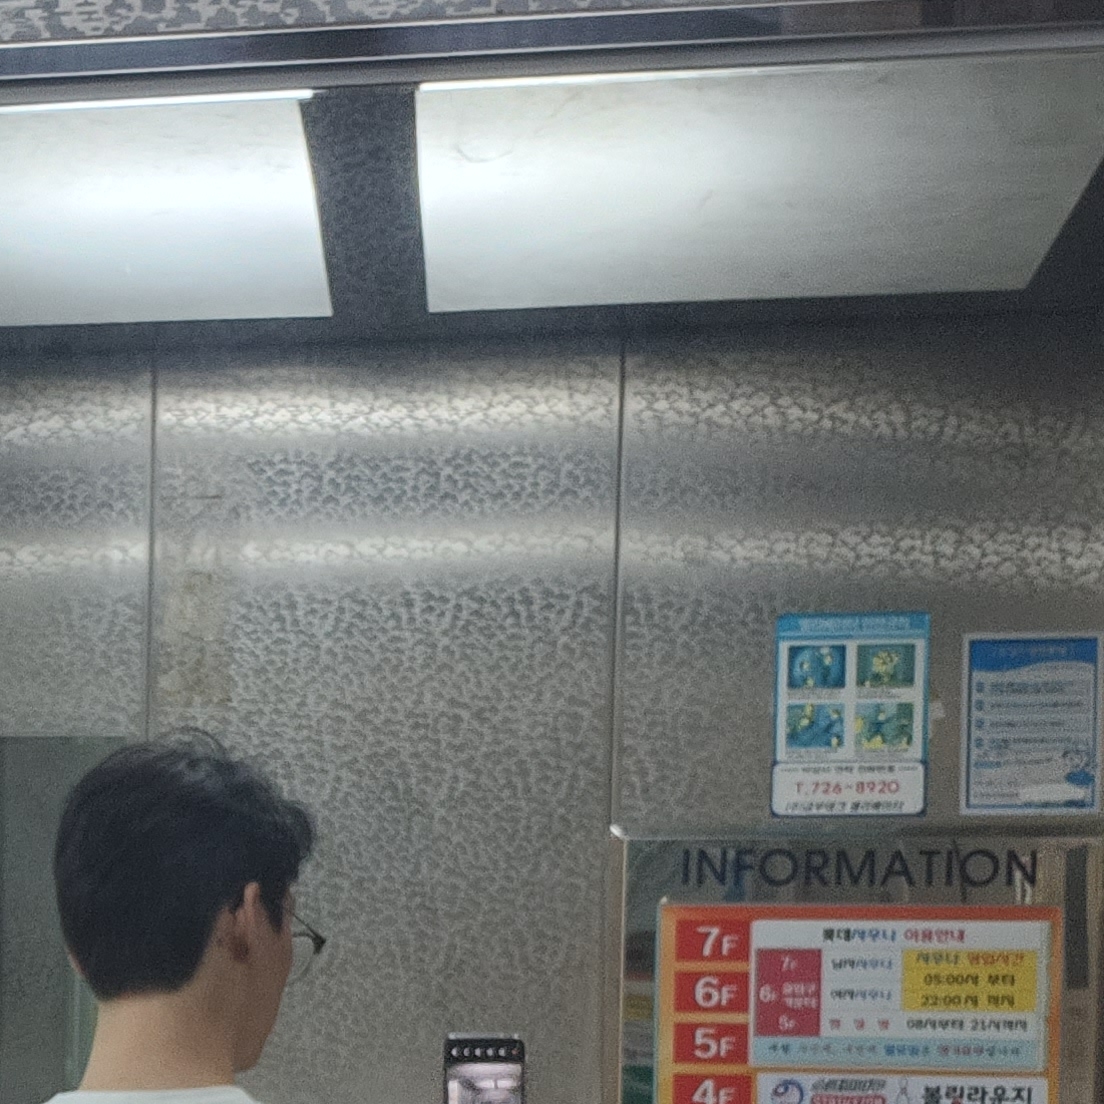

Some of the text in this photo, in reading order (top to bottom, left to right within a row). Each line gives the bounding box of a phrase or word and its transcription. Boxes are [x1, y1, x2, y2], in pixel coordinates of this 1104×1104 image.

[681, 848, 1038, 887] INFORMATION
[696, 925, 739, 957] 7F
[694, 975, 738, 1009] 6F
[694, 1027, 736, 1059] 5F
